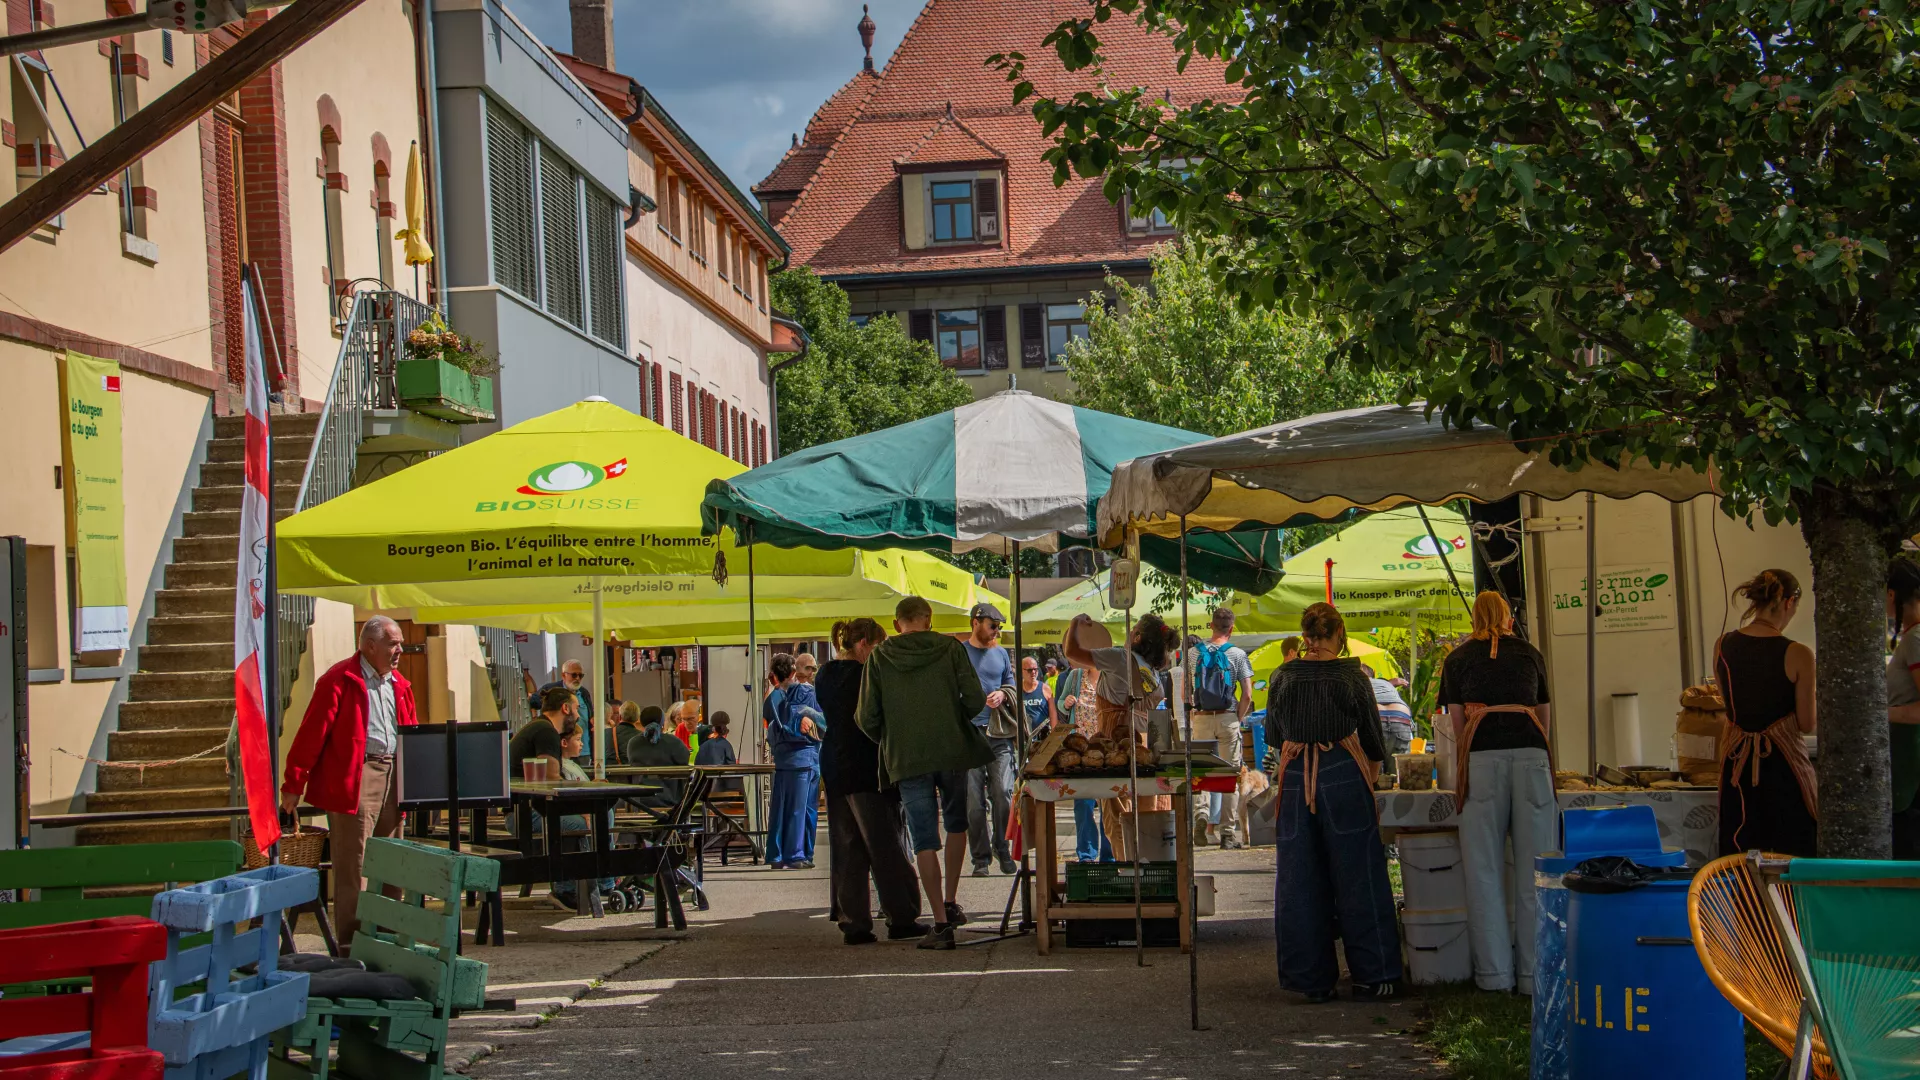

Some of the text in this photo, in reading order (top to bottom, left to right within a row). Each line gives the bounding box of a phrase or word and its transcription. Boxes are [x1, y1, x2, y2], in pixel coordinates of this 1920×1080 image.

[72, 398, 103, 420] Le Bourgeon
[77, 419, 84, 435] du
[388, 533, 717, 558] Bourgeon Bio. L'équilibre entre l'homme,
[468, 553, 635, 571] l'animal et la nature.
[1349, 590, 1392, 601] Knospe.
[1394, 588, 1427, 599] Bringt
[1429, 587, 1448, 596] den
[1554, 588, 1656, 610] Machon
[1566, 978, 1651, 1032] LLE
